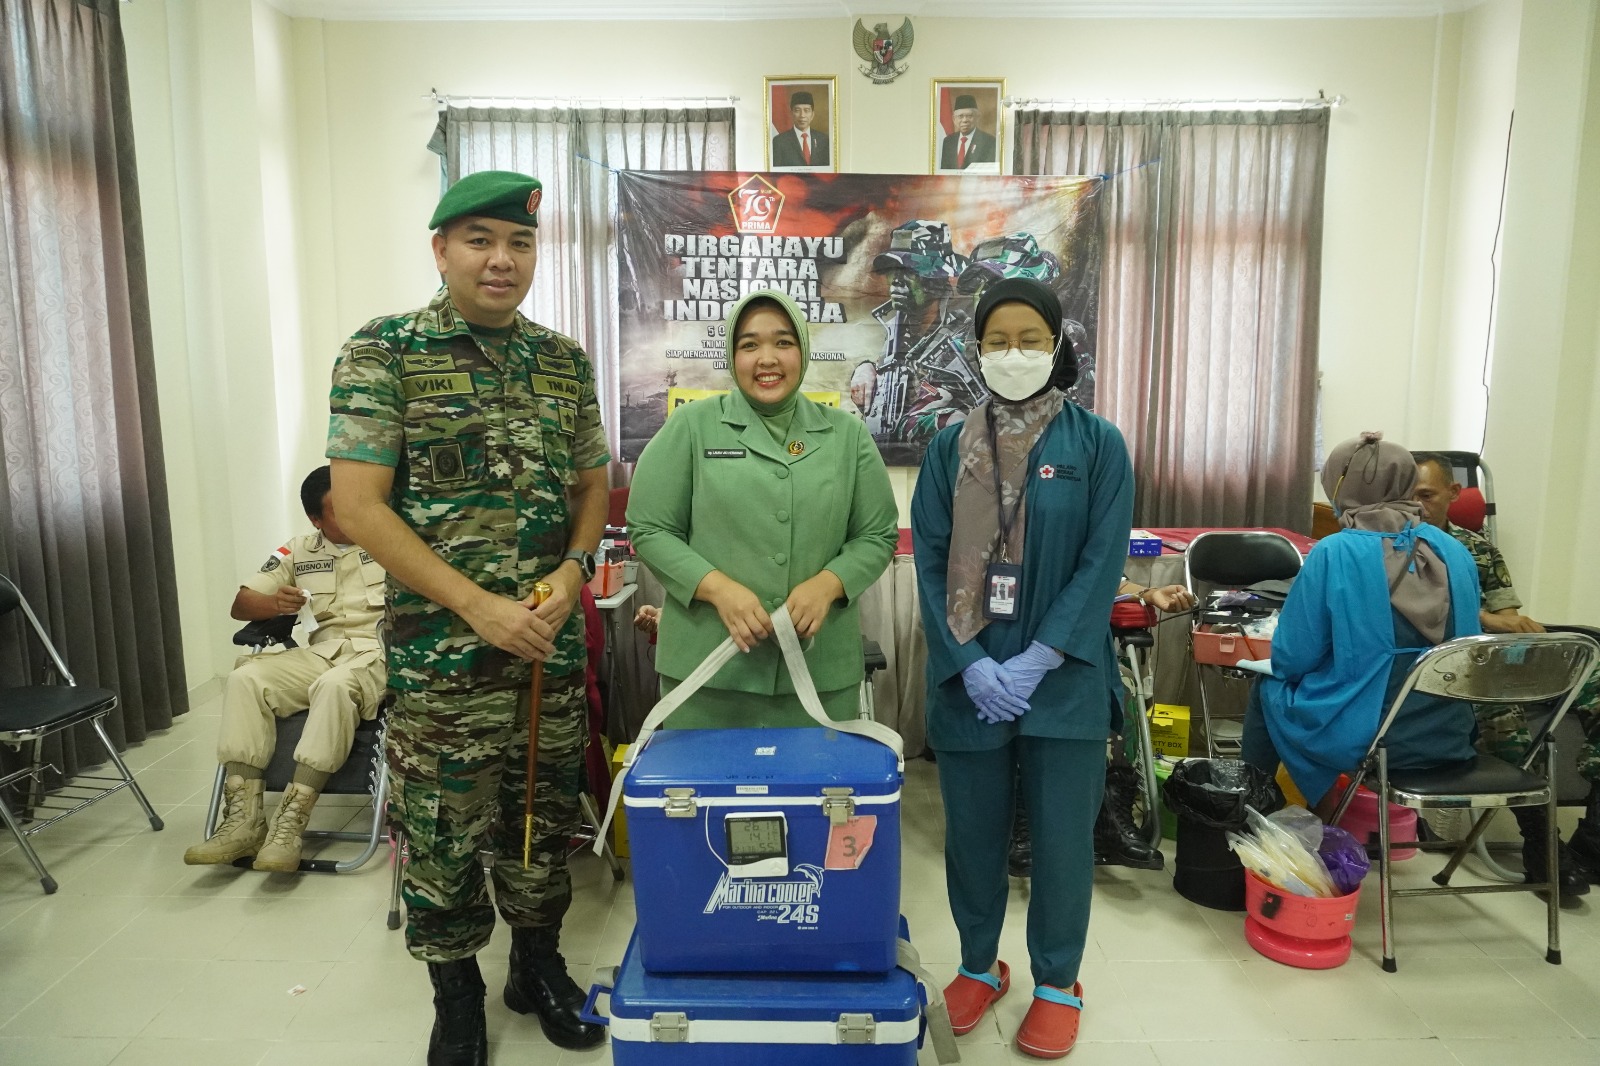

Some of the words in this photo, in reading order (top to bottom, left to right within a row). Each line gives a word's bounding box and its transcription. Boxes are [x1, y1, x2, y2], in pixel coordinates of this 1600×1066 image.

[741, 221, 771, 230] PRIMA
[664, 234, 845, 258] DIRGAHAYU
[681, 257, 819, 279] TENTARA
[702, 340, 715, 348] TNI
[666, 350, 682, 358] SIAP
[683, 350, 723, 358] MENGAWAL
[810, 352, 846, 361] NASIONAL
[713, 361, 728, 369] UNT
[415, 378, 453, 393] VIKI
[546, 380, 565, 392] TNI
[565, 383, 578, 395] AD
[296, 561, 332, 572] KUSNO.W
[842, 835, 858, 858] 3
[777, 904, 820, 924] 24S
